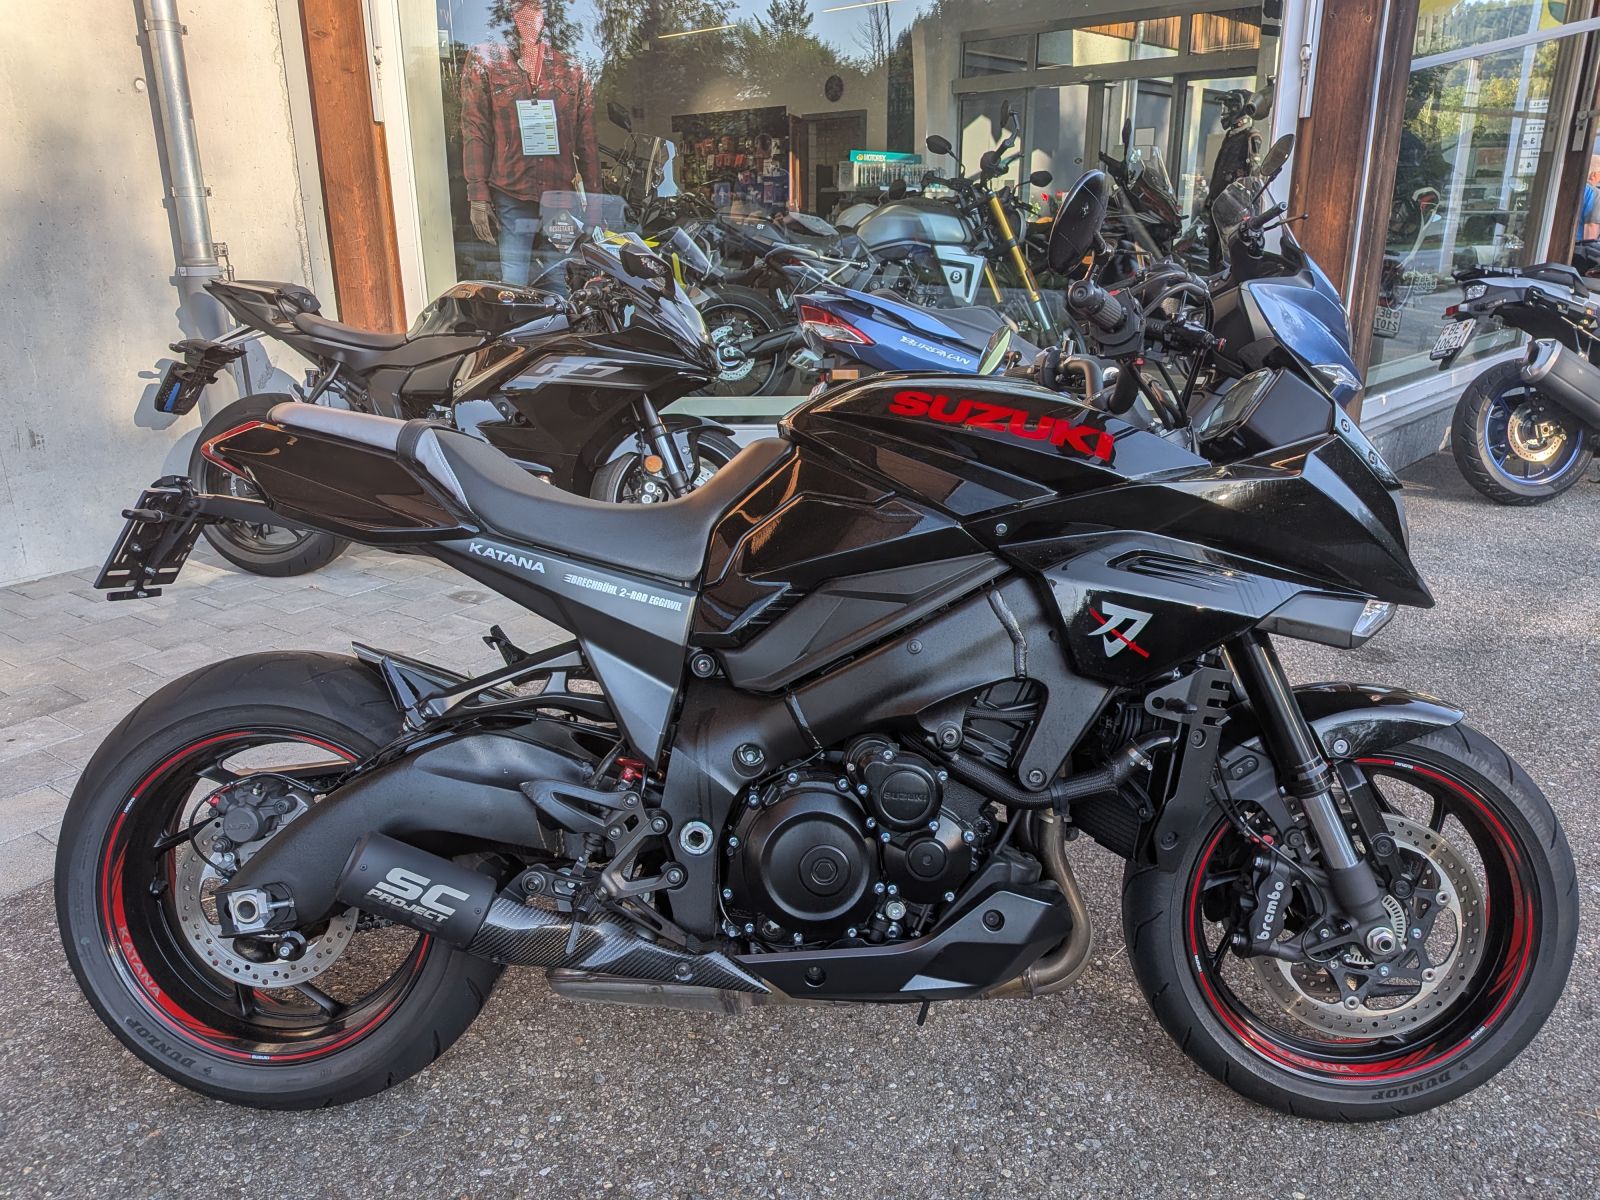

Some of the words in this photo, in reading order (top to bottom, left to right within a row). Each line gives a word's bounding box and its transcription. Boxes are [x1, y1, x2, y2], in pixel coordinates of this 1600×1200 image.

[952, 270, 960, 281] 8
[1448, 323, 1461, 335] BE
[900, 335, 970, 365] BURGMAN
[888, 390, 1115, 462] SUZUKI
[468, 542, 545, 574] KATANA
[568, 574, 618, 596] BRECHBÜHL
[618, 587, 648, 604] 2-RAD
[648, 595, 682, 612] EGGIWIL
[883, 792, 928, 802] SUZUKI
[366, 888, 449, 923] PROJECT
[375, 867, 471, 917] SC
[1256, 881, 1285, 940] brembo
[117, 926, 162, 998] KATANA
[124, 1016, 197, 1068] DUNLOP
[1371, 1070, 1451, 1100] DUNLOP
